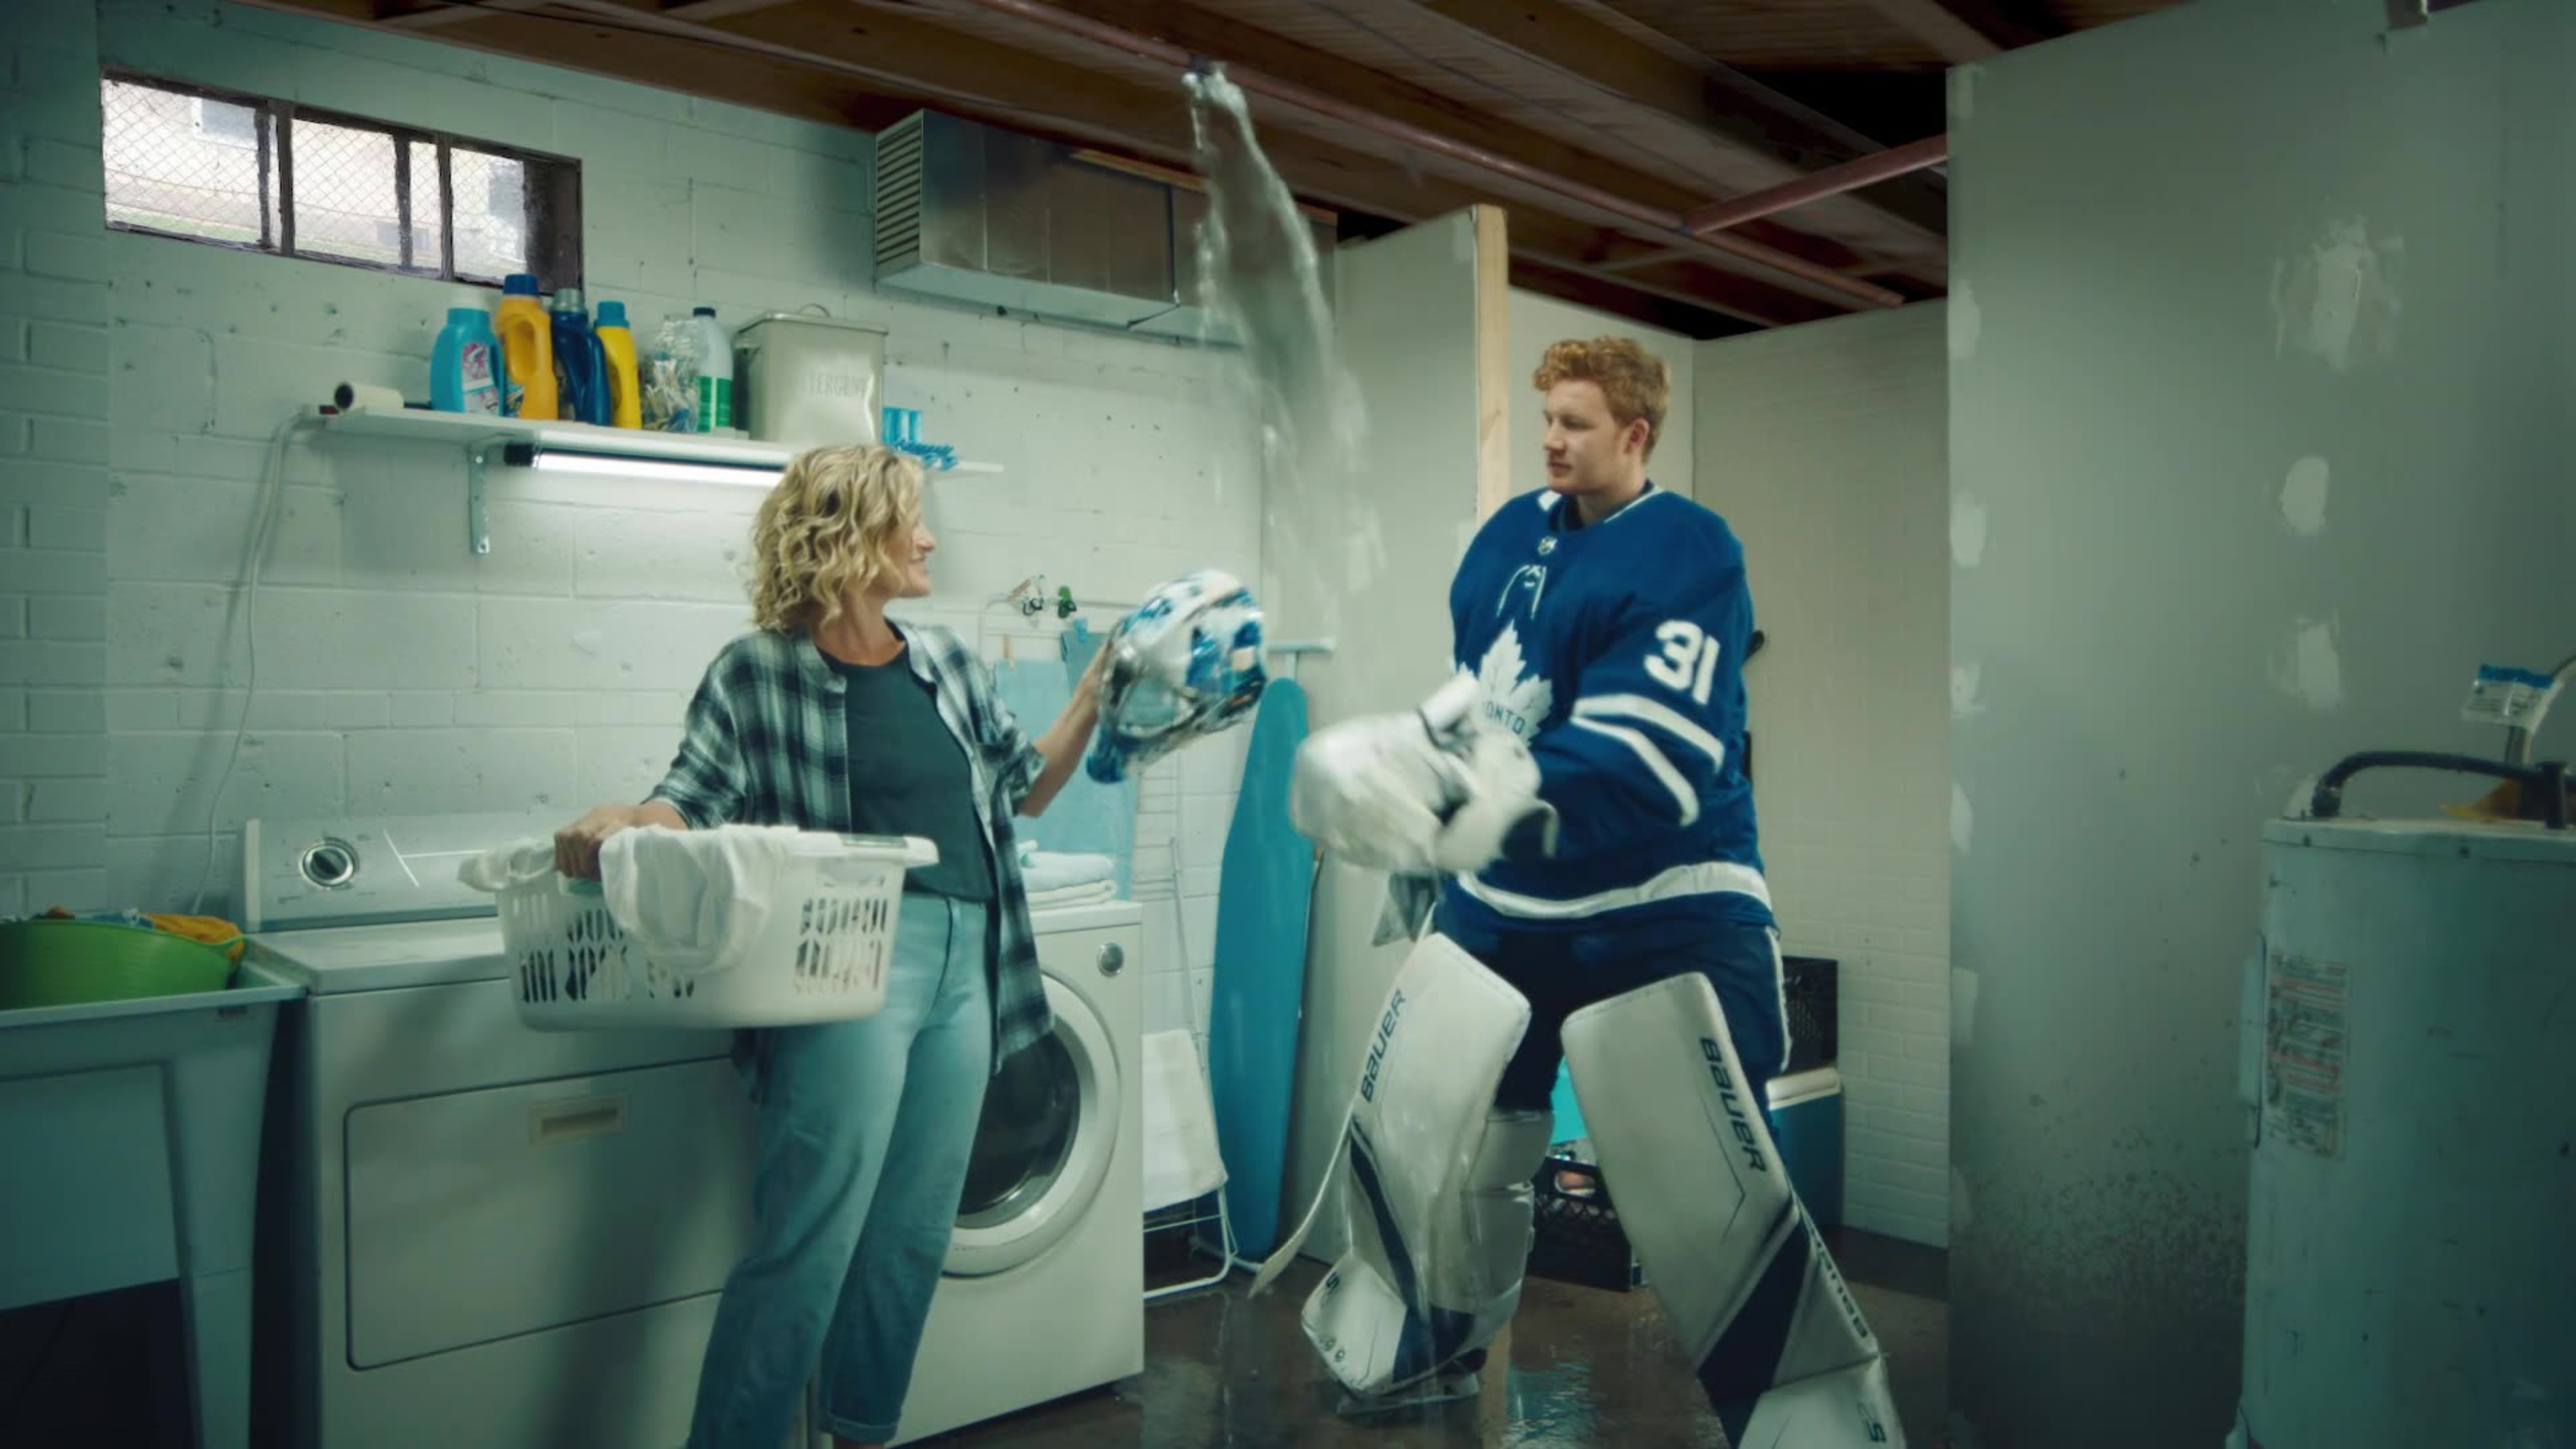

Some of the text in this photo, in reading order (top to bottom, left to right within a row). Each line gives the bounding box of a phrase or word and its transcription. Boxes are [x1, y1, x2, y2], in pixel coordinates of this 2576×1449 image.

[1644, 619, 1721, 706] 31
[1484, 700, 1526, 736] ONTO
[1360, 989, 1406, 1103] BAUER
[1699, 1037, 1767, 1173] BAUER
